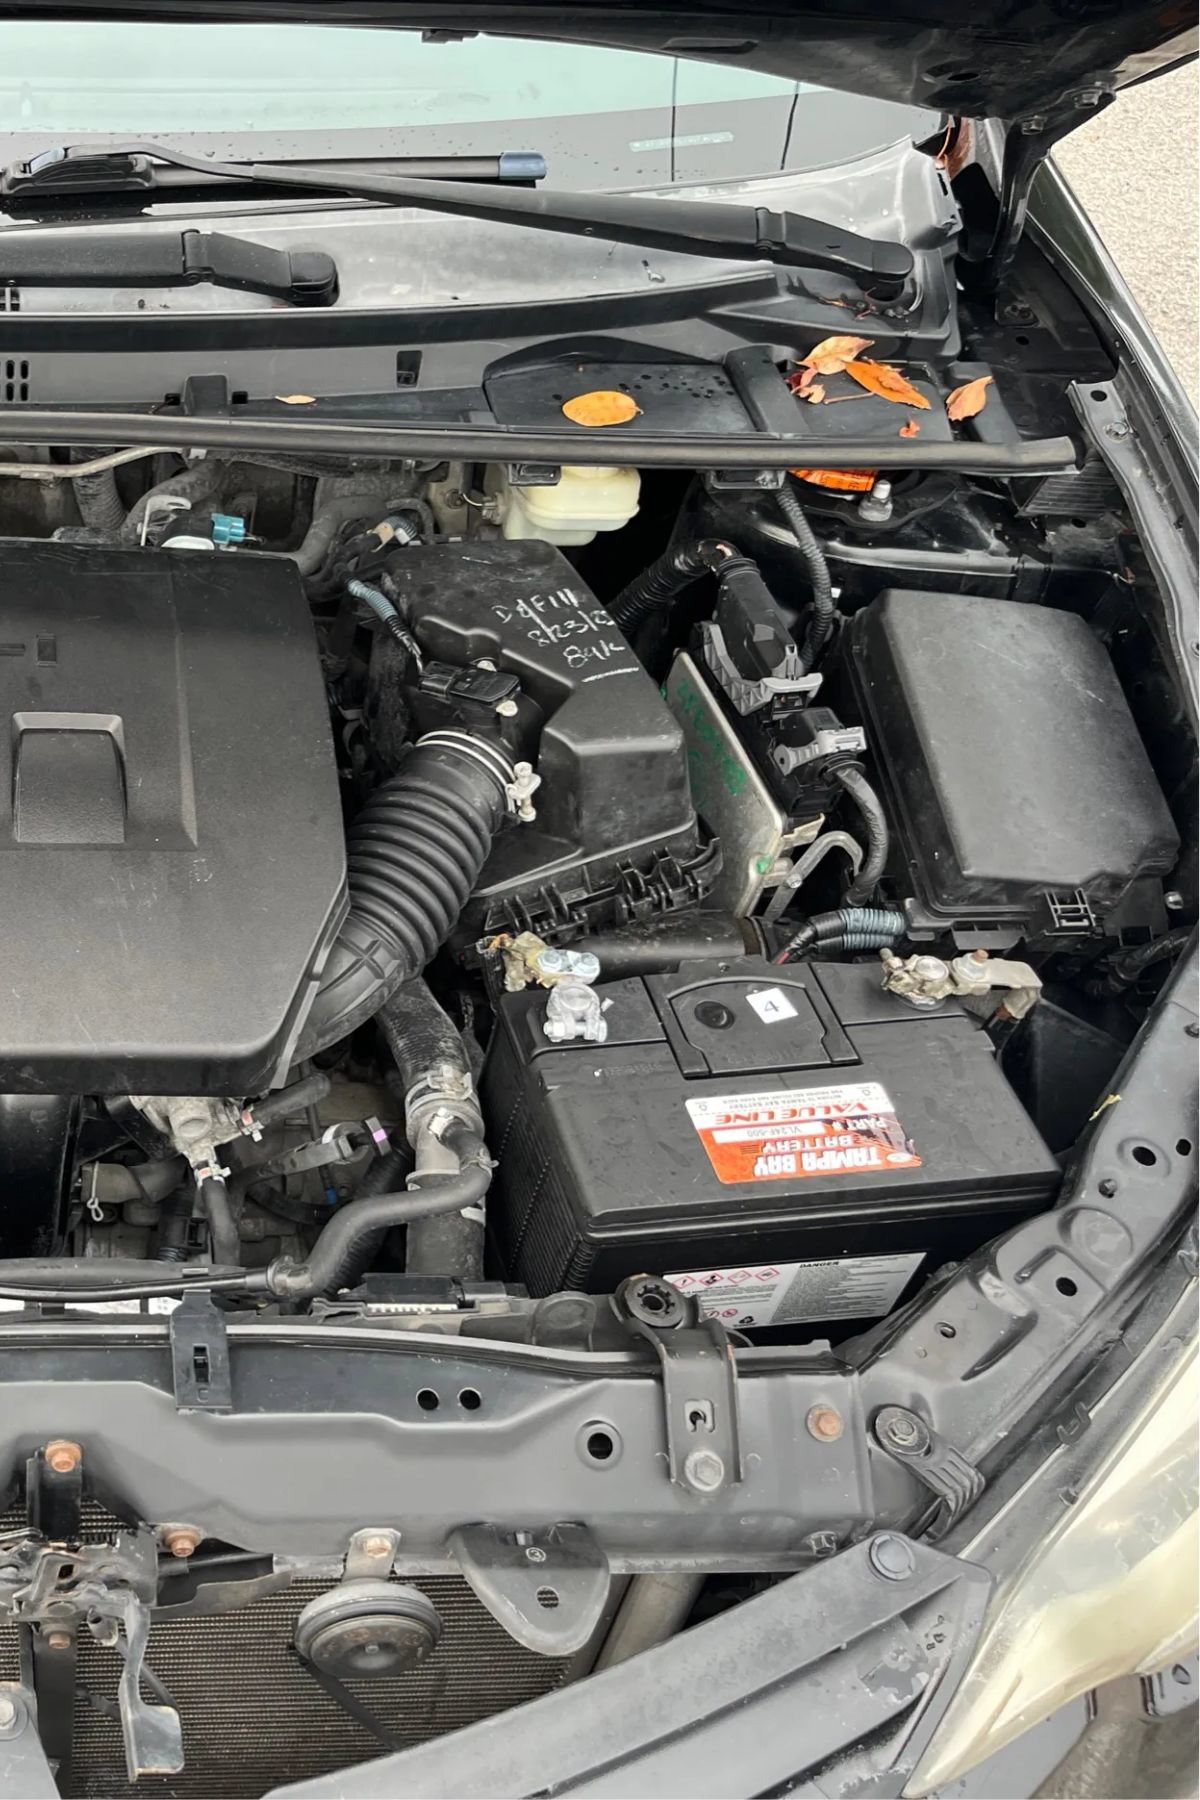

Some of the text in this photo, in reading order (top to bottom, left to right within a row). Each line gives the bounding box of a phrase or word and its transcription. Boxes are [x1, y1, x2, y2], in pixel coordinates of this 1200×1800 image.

[764, 1001, 780, 1012] 4
[715, 1103, 868, 1125] VALUE LINE
[847, 1117, 888, 1130] PART
[762, 1135, 852, 1154] BATTERY
[753, 1146, 882, 1177] TAMPA BAY
